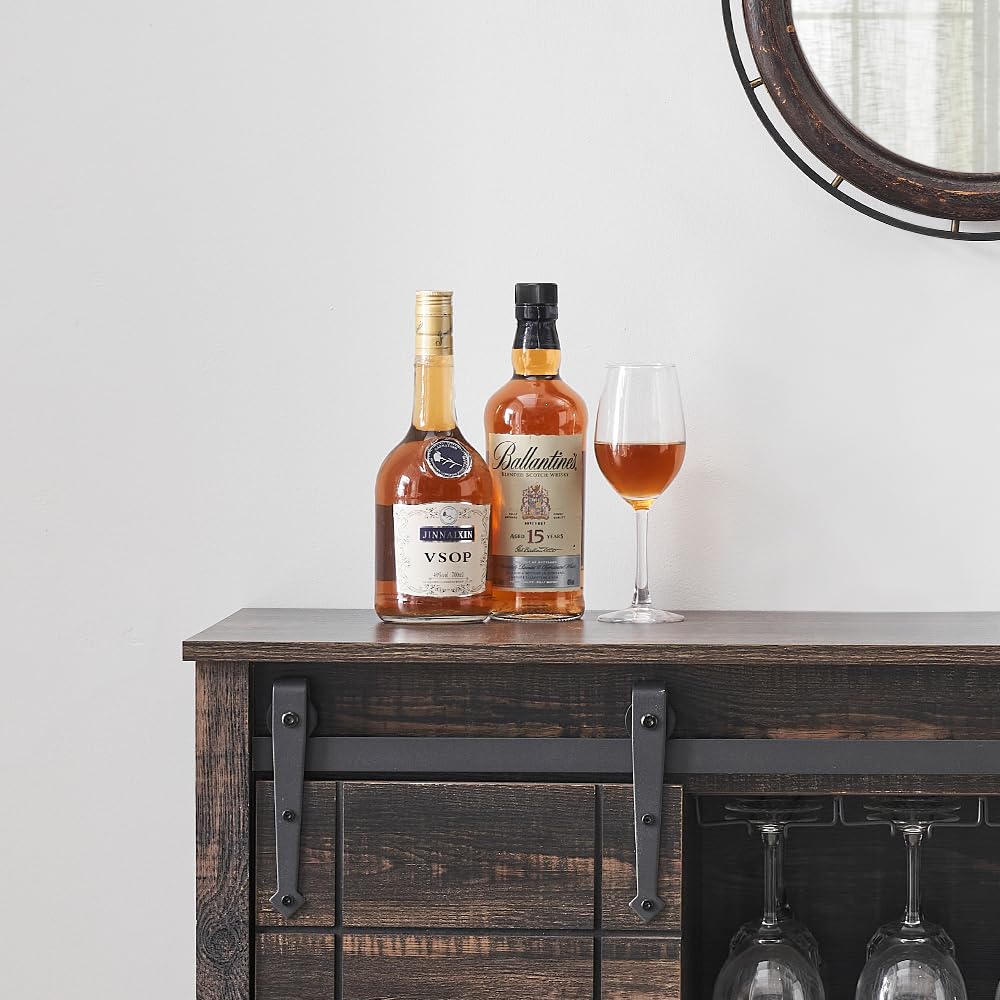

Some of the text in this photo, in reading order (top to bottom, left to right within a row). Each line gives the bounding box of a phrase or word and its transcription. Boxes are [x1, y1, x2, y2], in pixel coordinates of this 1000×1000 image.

[492, 440, 578, 471] Ballantine's
[527, 529, 545, 544] 15
[424, 551, 472, 563] VSOP
